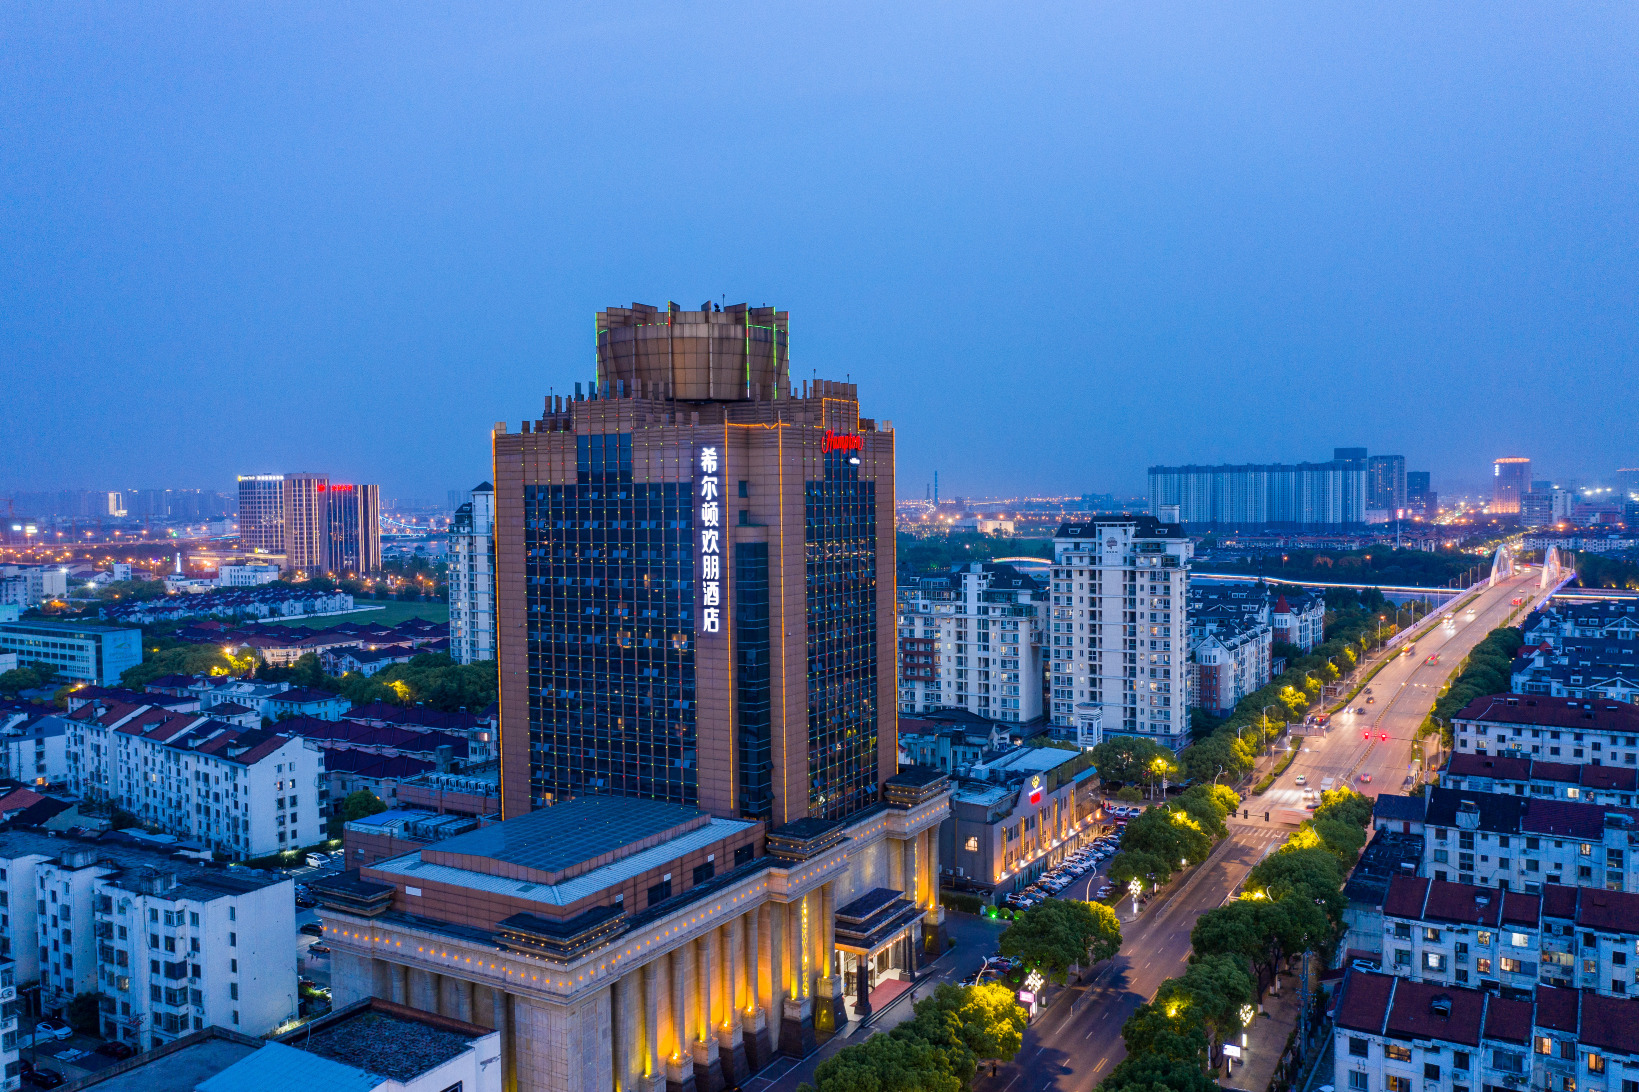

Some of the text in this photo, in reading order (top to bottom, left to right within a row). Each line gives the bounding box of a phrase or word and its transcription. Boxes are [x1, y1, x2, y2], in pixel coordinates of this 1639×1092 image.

[822, 427, 864, 454] Hampton
[701, 447, 720, 633] 希尔顿欢朋酒店
